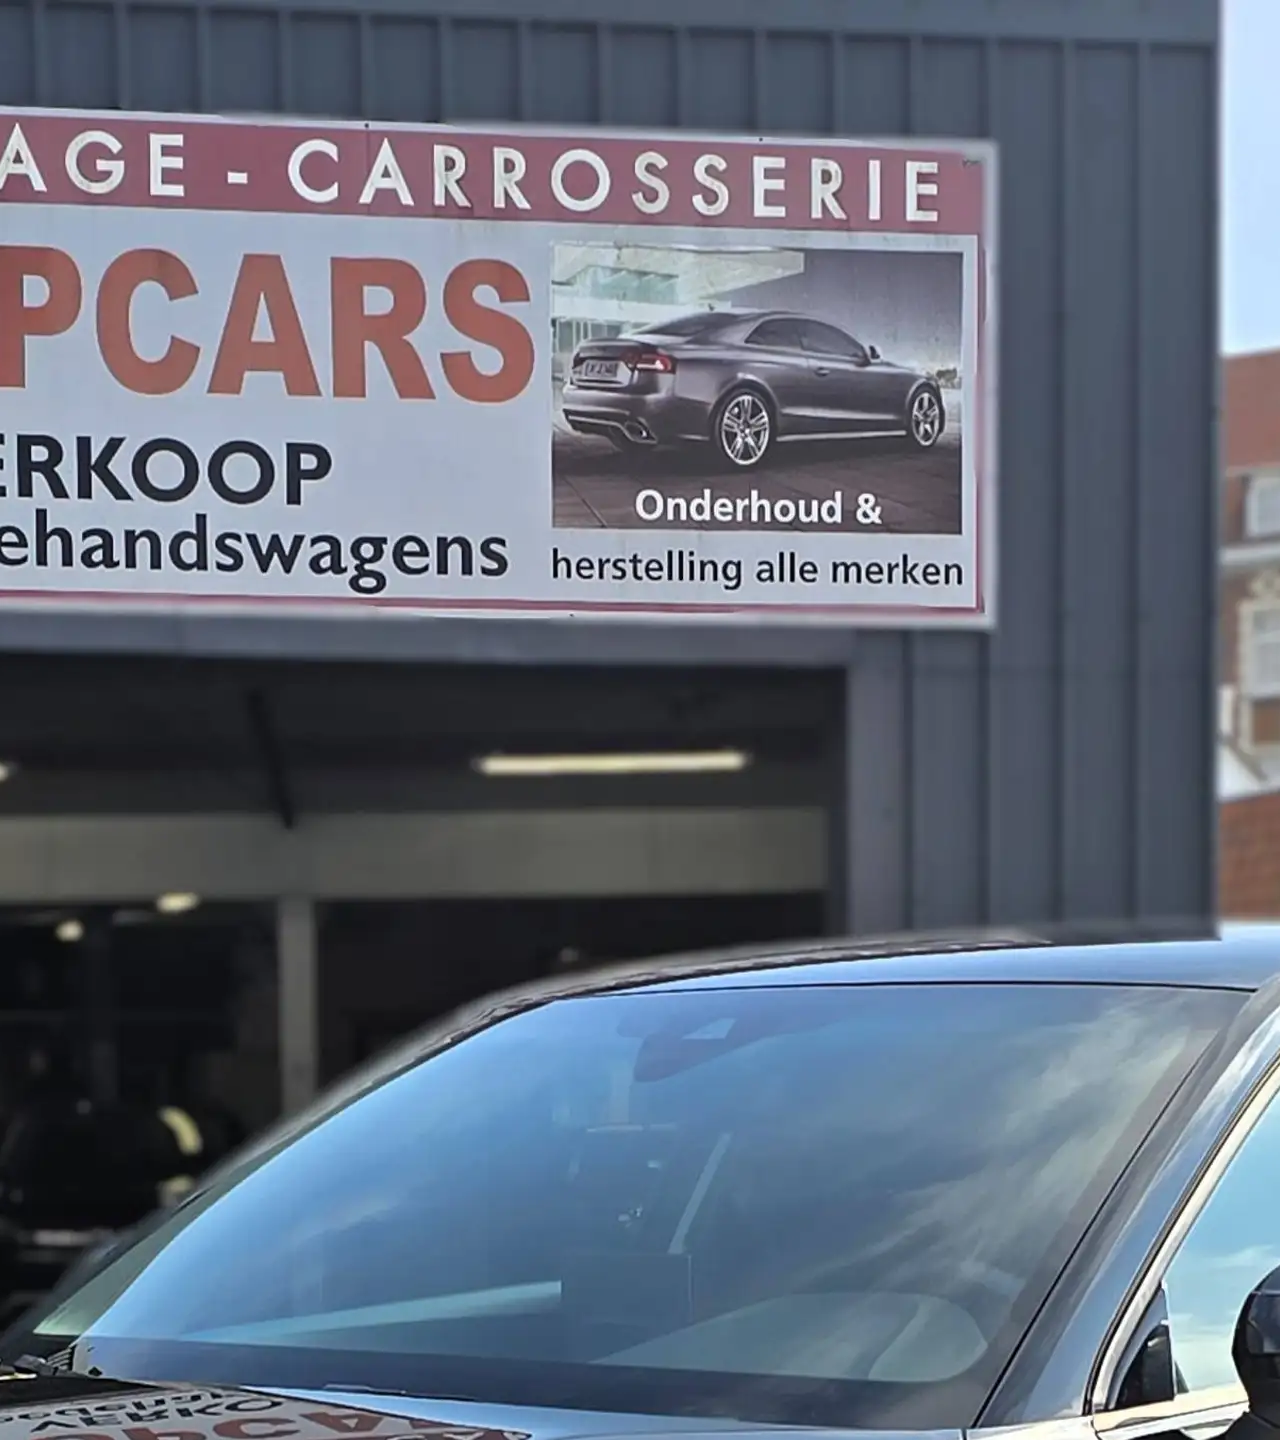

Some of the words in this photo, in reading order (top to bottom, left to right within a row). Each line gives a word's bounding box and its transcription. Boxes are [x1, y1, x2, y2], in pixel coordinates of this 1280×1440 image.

[287, 136, 941, 223] CARROSSERIE
[635, 488, 843, 525] Onderhoud
[855, 492, 884, 525] &
[551, 547, 743, 591] herstelling
[756, 551, 819, 584] alle
[831, 553, 964, 586] merken
